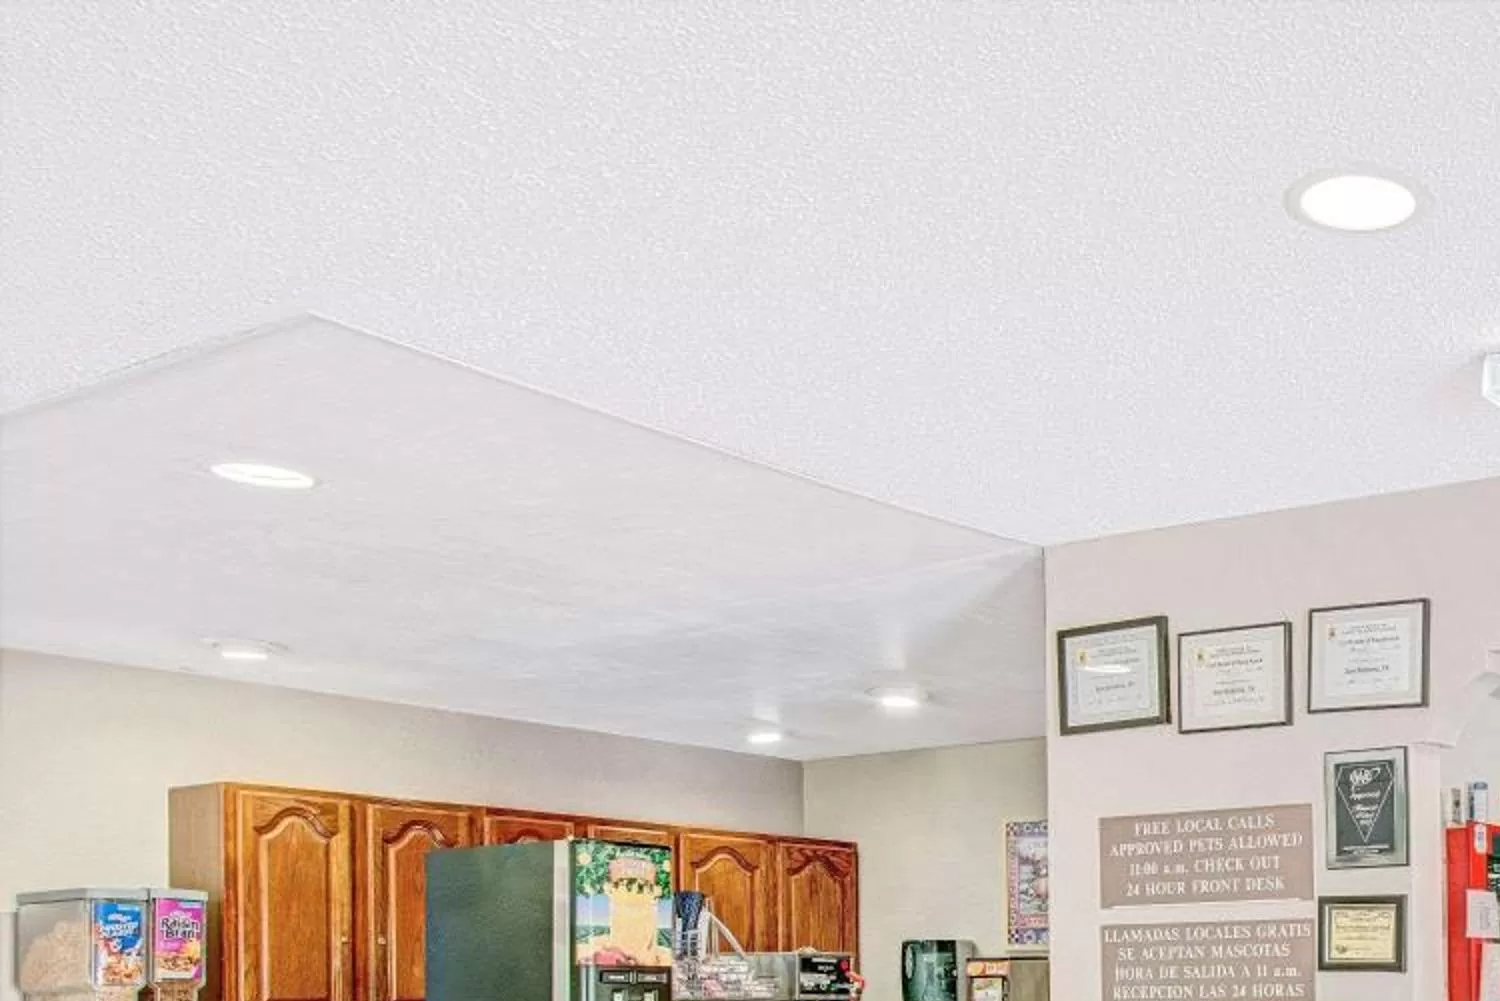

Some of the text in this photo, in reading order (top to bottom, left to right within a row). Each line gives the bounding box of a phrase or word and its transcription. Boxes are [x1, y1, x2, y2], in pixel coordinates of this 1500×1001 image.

[1134, 812, 1276, 836] FREE LOCAL CALLS
[1109, 832, 1303, 857] APPROVED PETS ALLOWED
[1194, 856, 1246, 873] CHECK
[1250, 855, 1281, 870] OUT
[1125, 876, 1286, 897] 24 HOUR FRONT DESK
[1103, 923, 1312, 944] LLAMADAS LOCALES GRATIS
[1118, 943, 1292, 961] SE ACEPTAN MASCOTAS
[1115, 964, 1154, 981] HORA
[1159, 965, 1179, 979] DE
[1183, 964, 1236, 979] SALIDA
[1241, 964, 1251, 978] A
[1113, 983, 1306, 1000] RECEPCION LAS 24 HORAS
